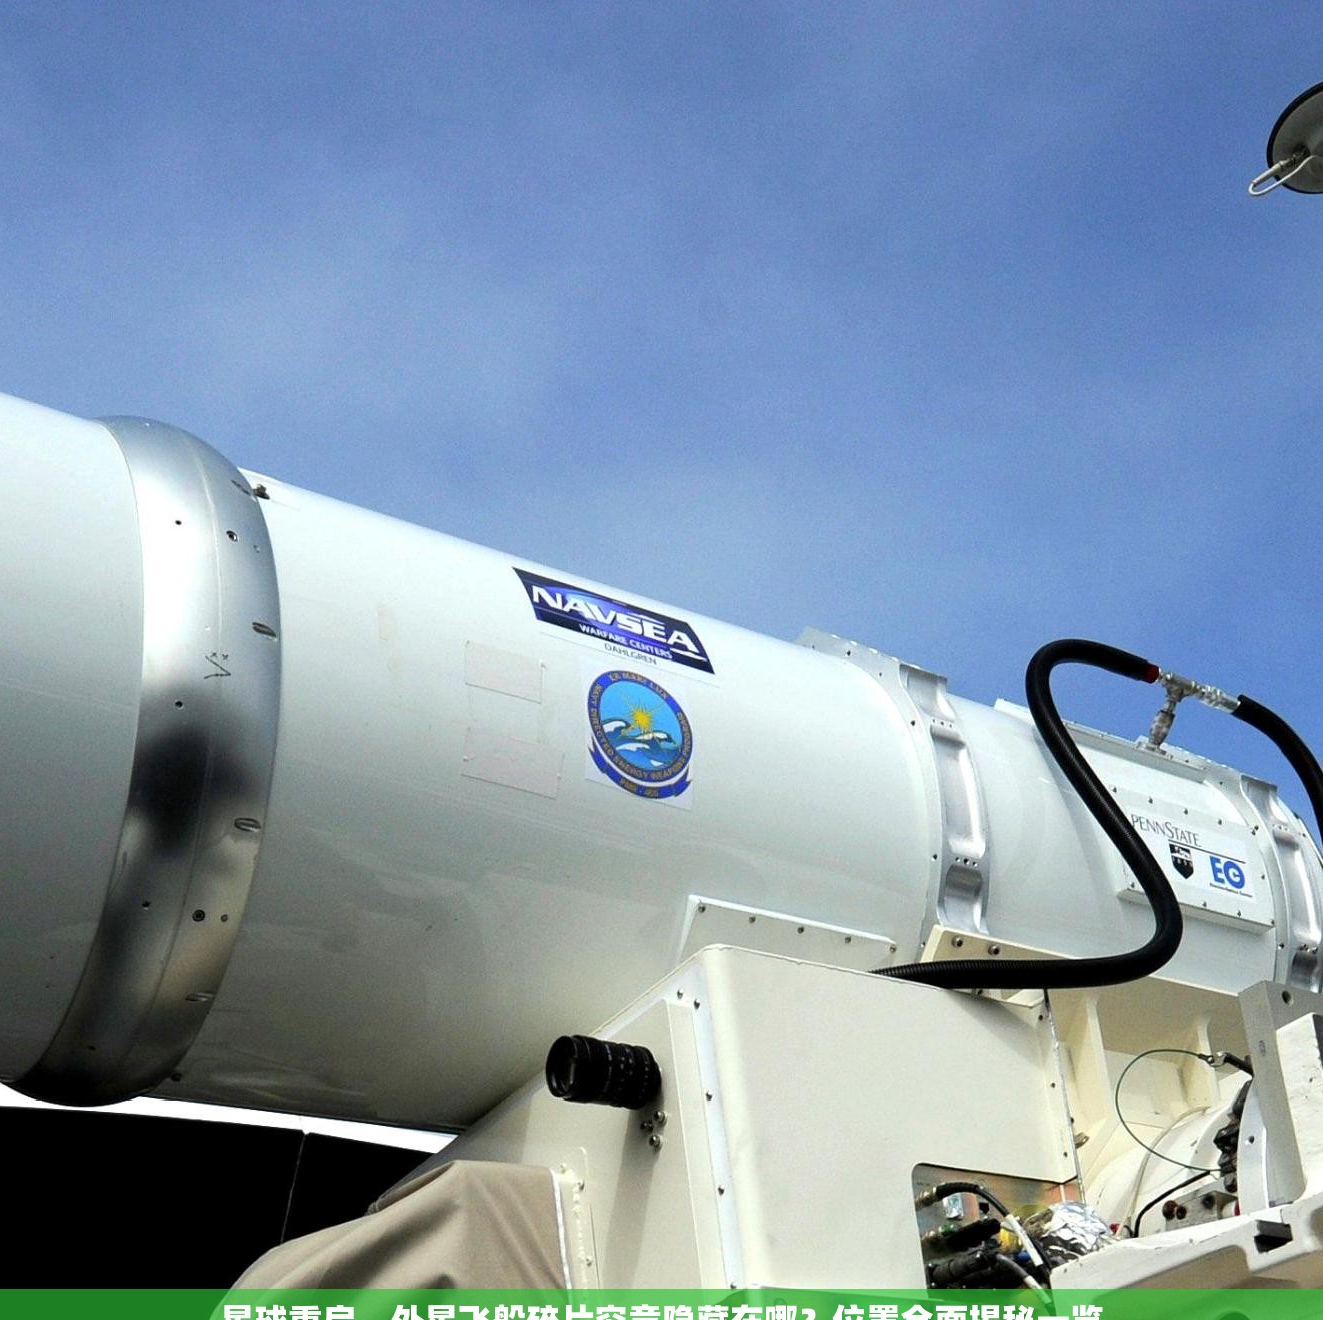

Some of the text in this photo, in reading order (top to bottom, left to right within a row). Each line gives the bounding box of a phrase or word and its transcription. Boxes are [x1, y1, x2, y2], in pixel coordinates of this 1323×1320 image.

[531, 585, 700, 653] NAVSEA
[579, 624, 673, 660] WARFARE CENTERS
[604, 643, 658, 666] DAHLGREN
